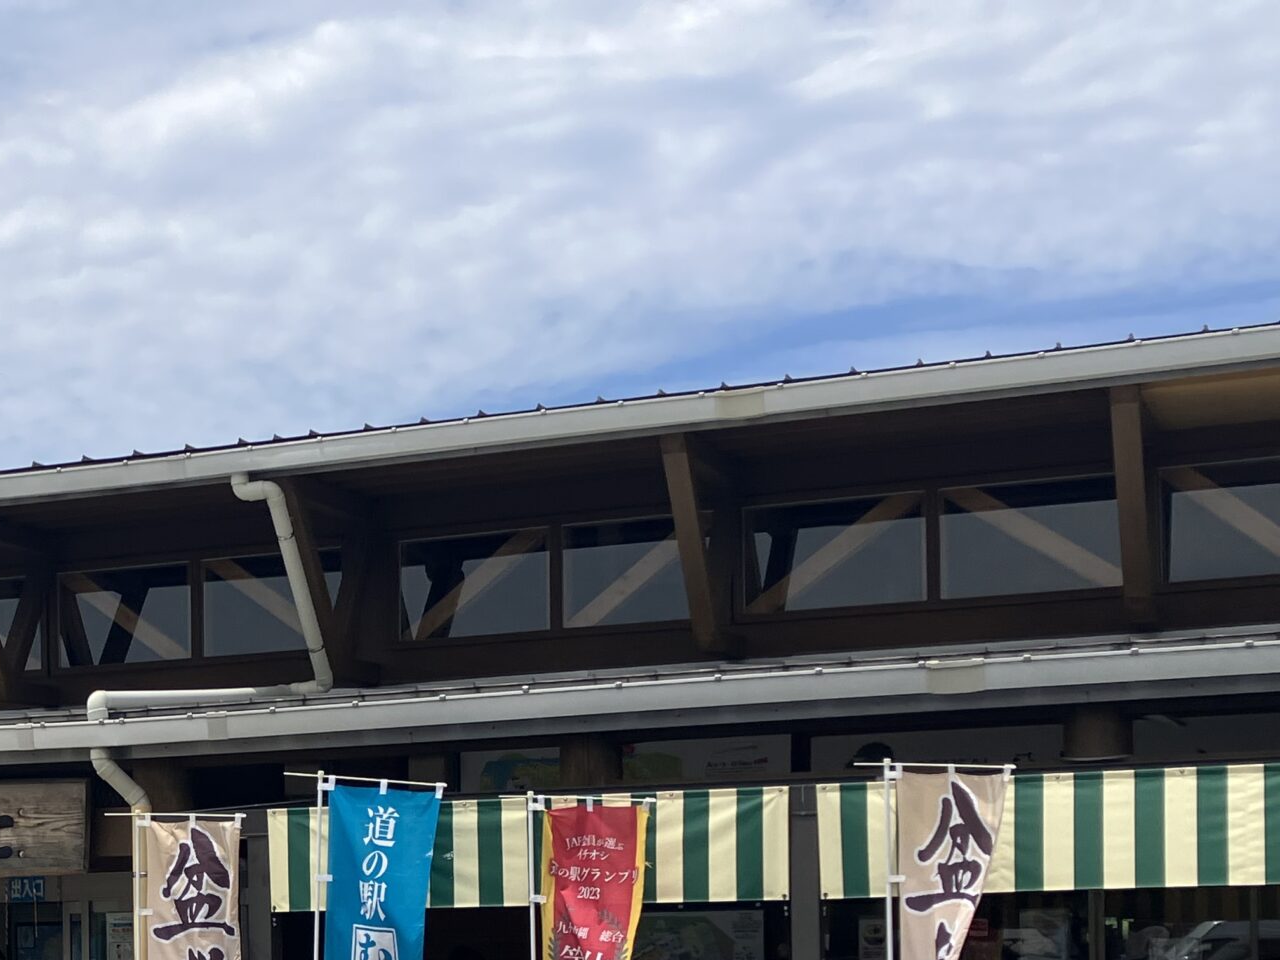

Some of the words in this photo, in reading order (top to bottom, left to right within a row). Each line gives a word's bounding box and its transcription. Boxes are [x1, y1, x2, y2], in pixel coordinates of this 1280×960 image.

[358, 806, 400, 921] 道の駅
[11, 879, 45, 899] 出入口
[577, 886, 600, 900] 2023
